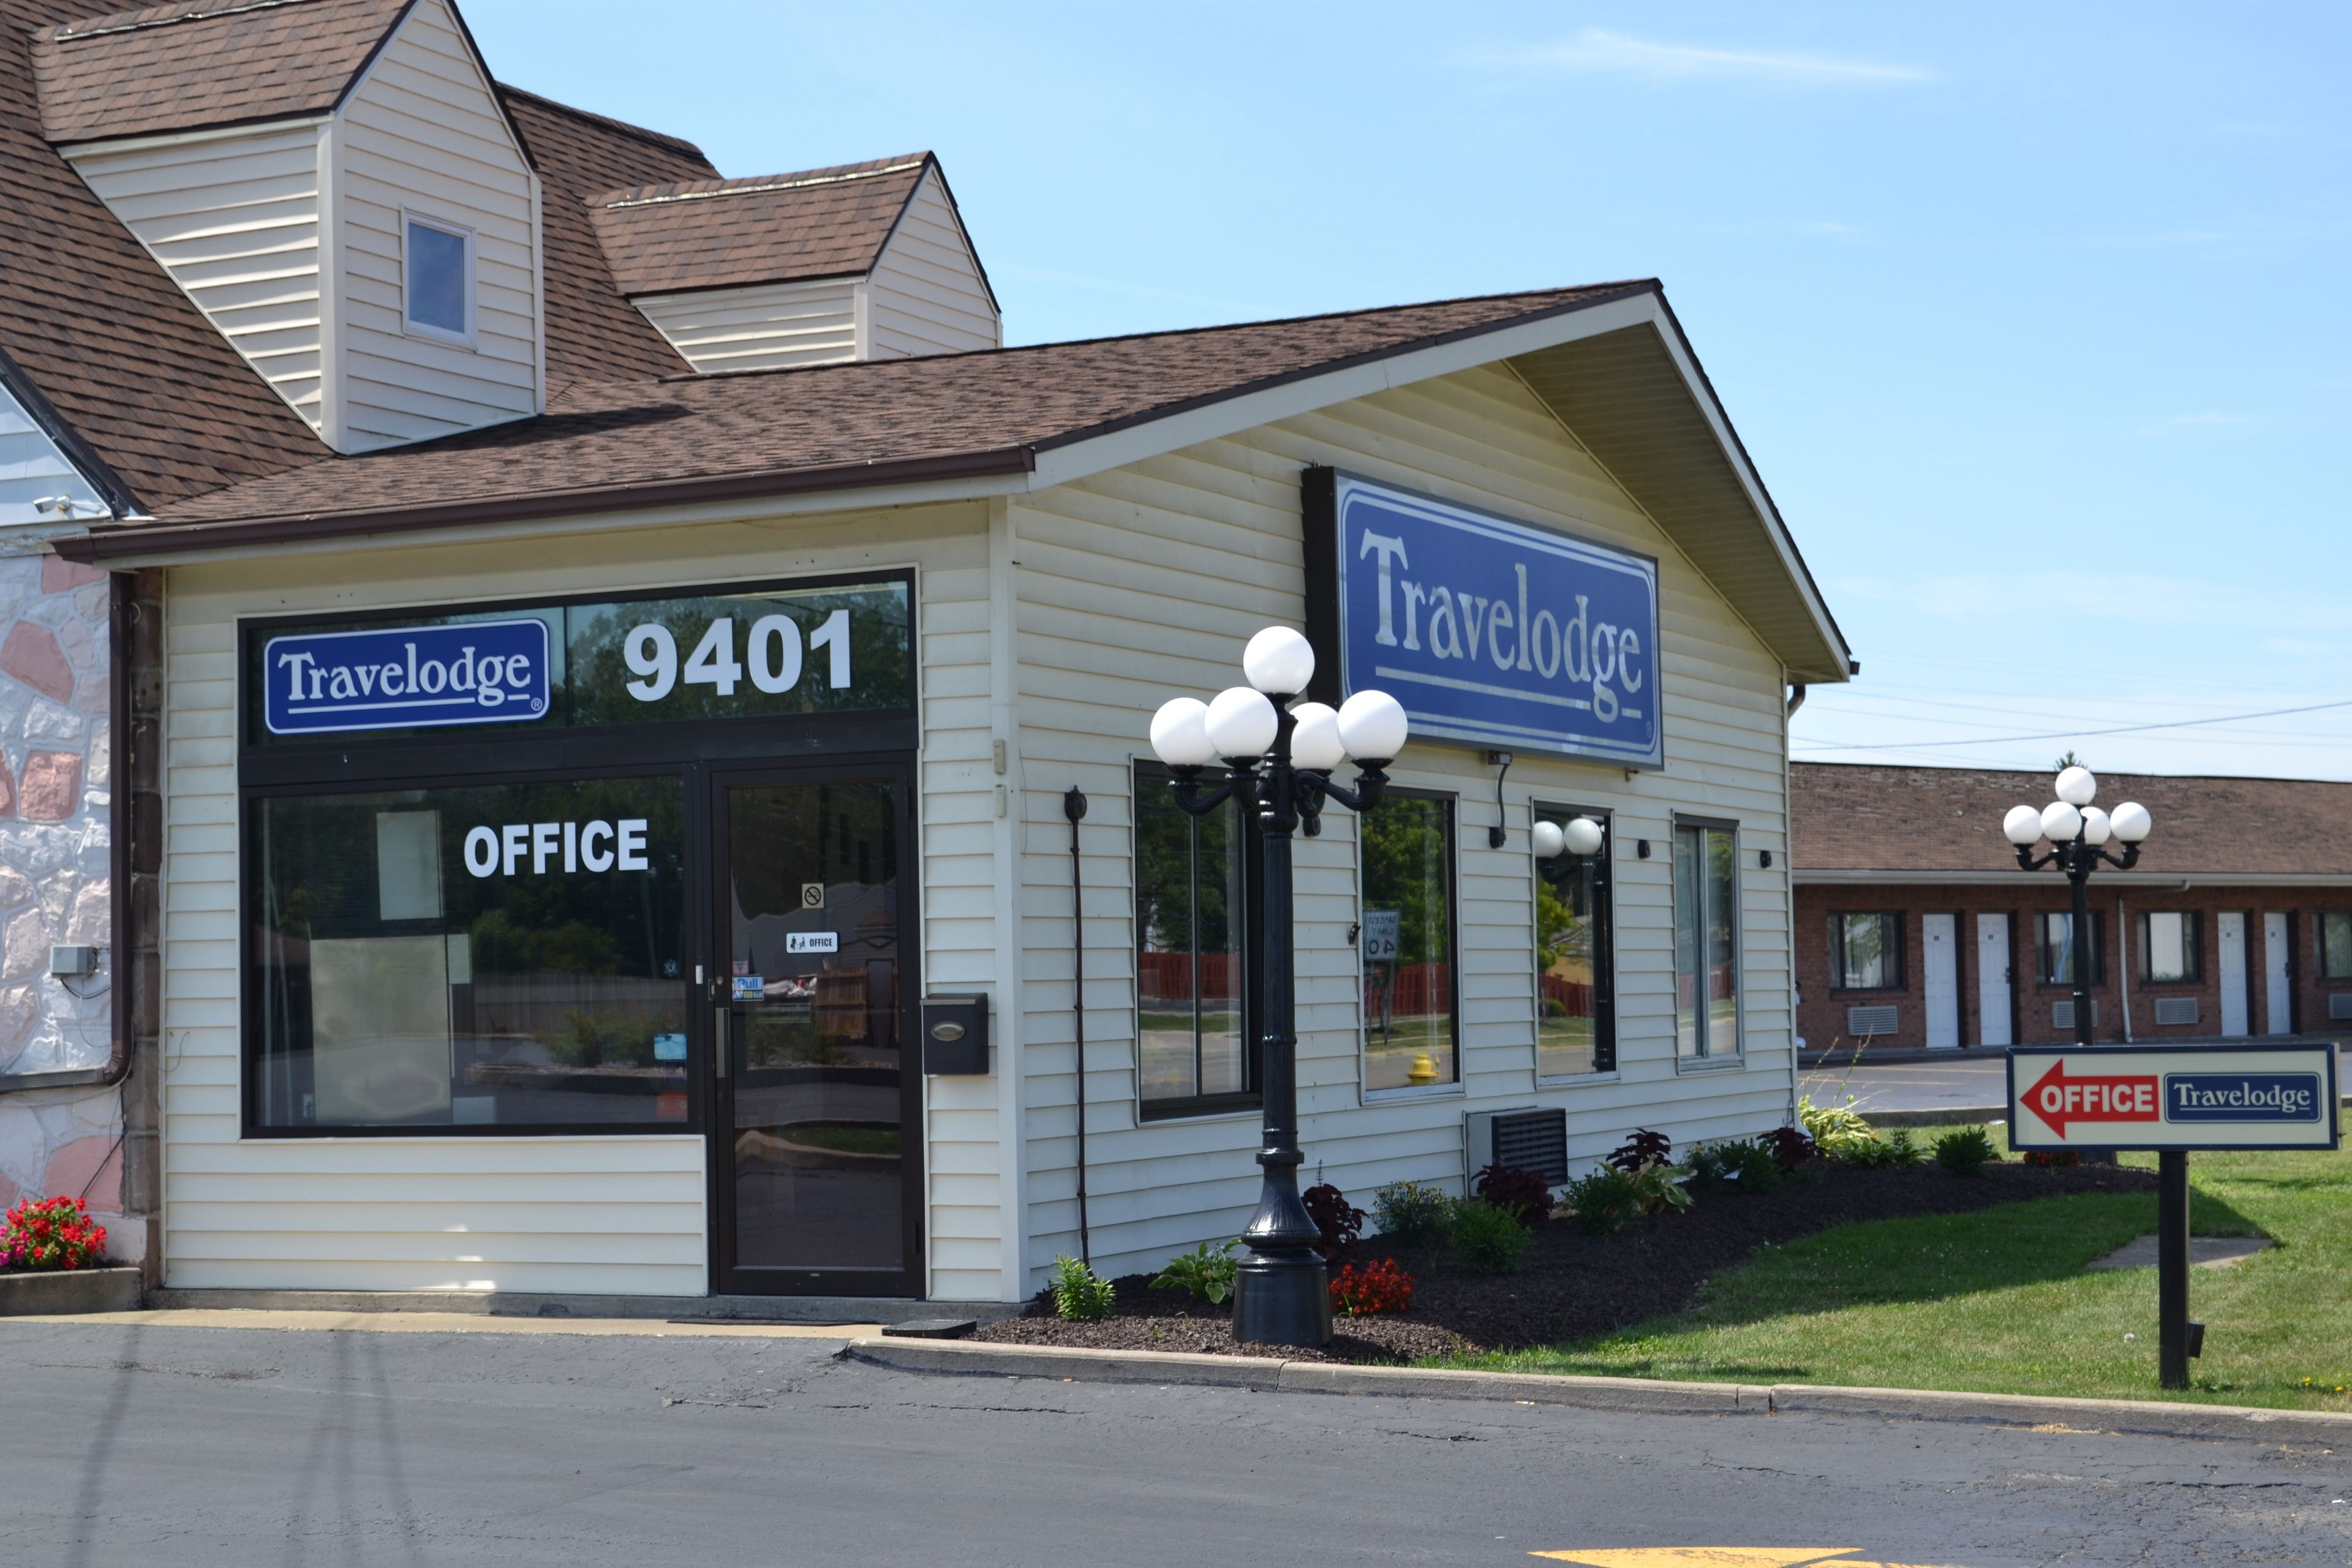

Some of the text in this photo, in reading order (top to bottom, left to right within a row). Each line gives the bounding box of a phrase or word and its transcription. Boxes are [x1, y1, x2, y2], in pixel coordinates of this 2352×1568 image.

[1360, 527, 1642, 723] Travelodge
[277, 643, 531, 707] Travelodge
[623, 609, 852, 702] 9401
[464, 819, 648, 878] OFFICE
[809, 938, 833, 948] OFFICE
[737, 978, 758, 989] Pull
[2040, 1085, 2154, 1113] OFFICE
[2174, 1082, 2310, 1113] Travelodge
